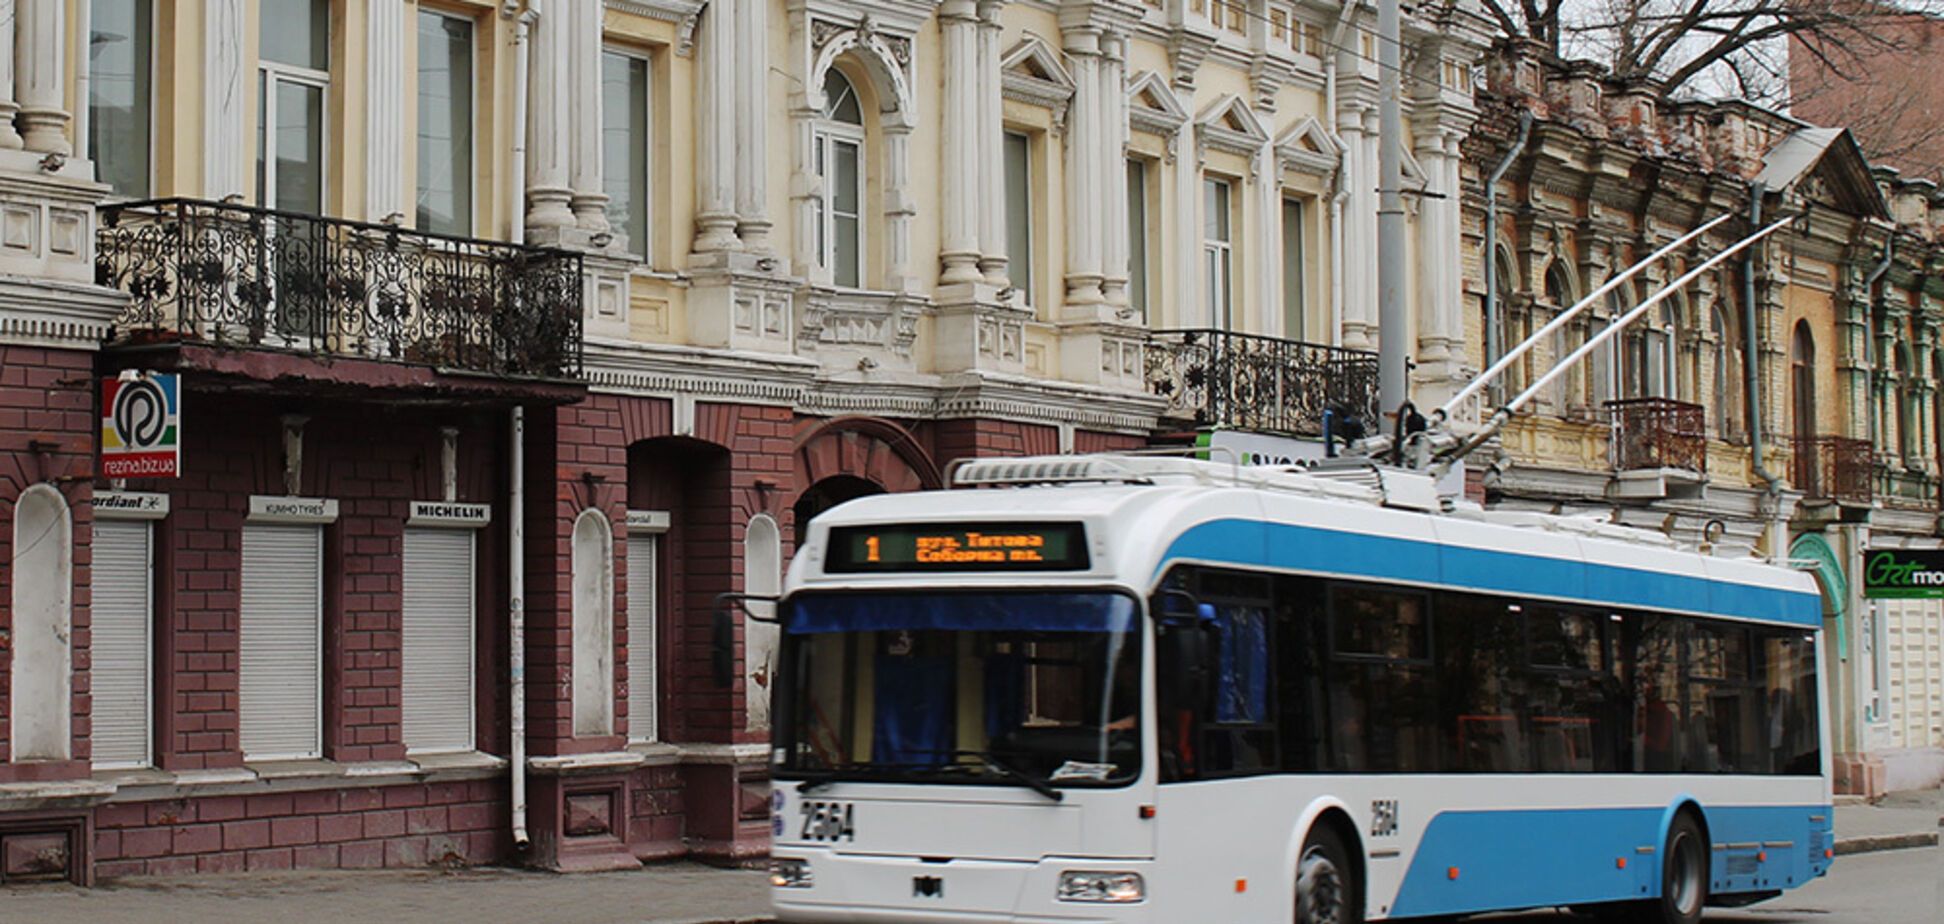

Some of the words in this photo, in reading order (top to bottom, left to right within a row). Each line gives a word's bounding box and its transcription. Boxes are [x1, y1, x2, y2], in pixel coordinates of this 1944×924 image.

[104, 457, 175, 475] rezina.biz.ua
[417, 504, 484, 519] MICHELIN
[865, 536, 880, 562] 1
[800, 801, 854, 842] 2564
[1371, 800, 1398, 836] 2564
